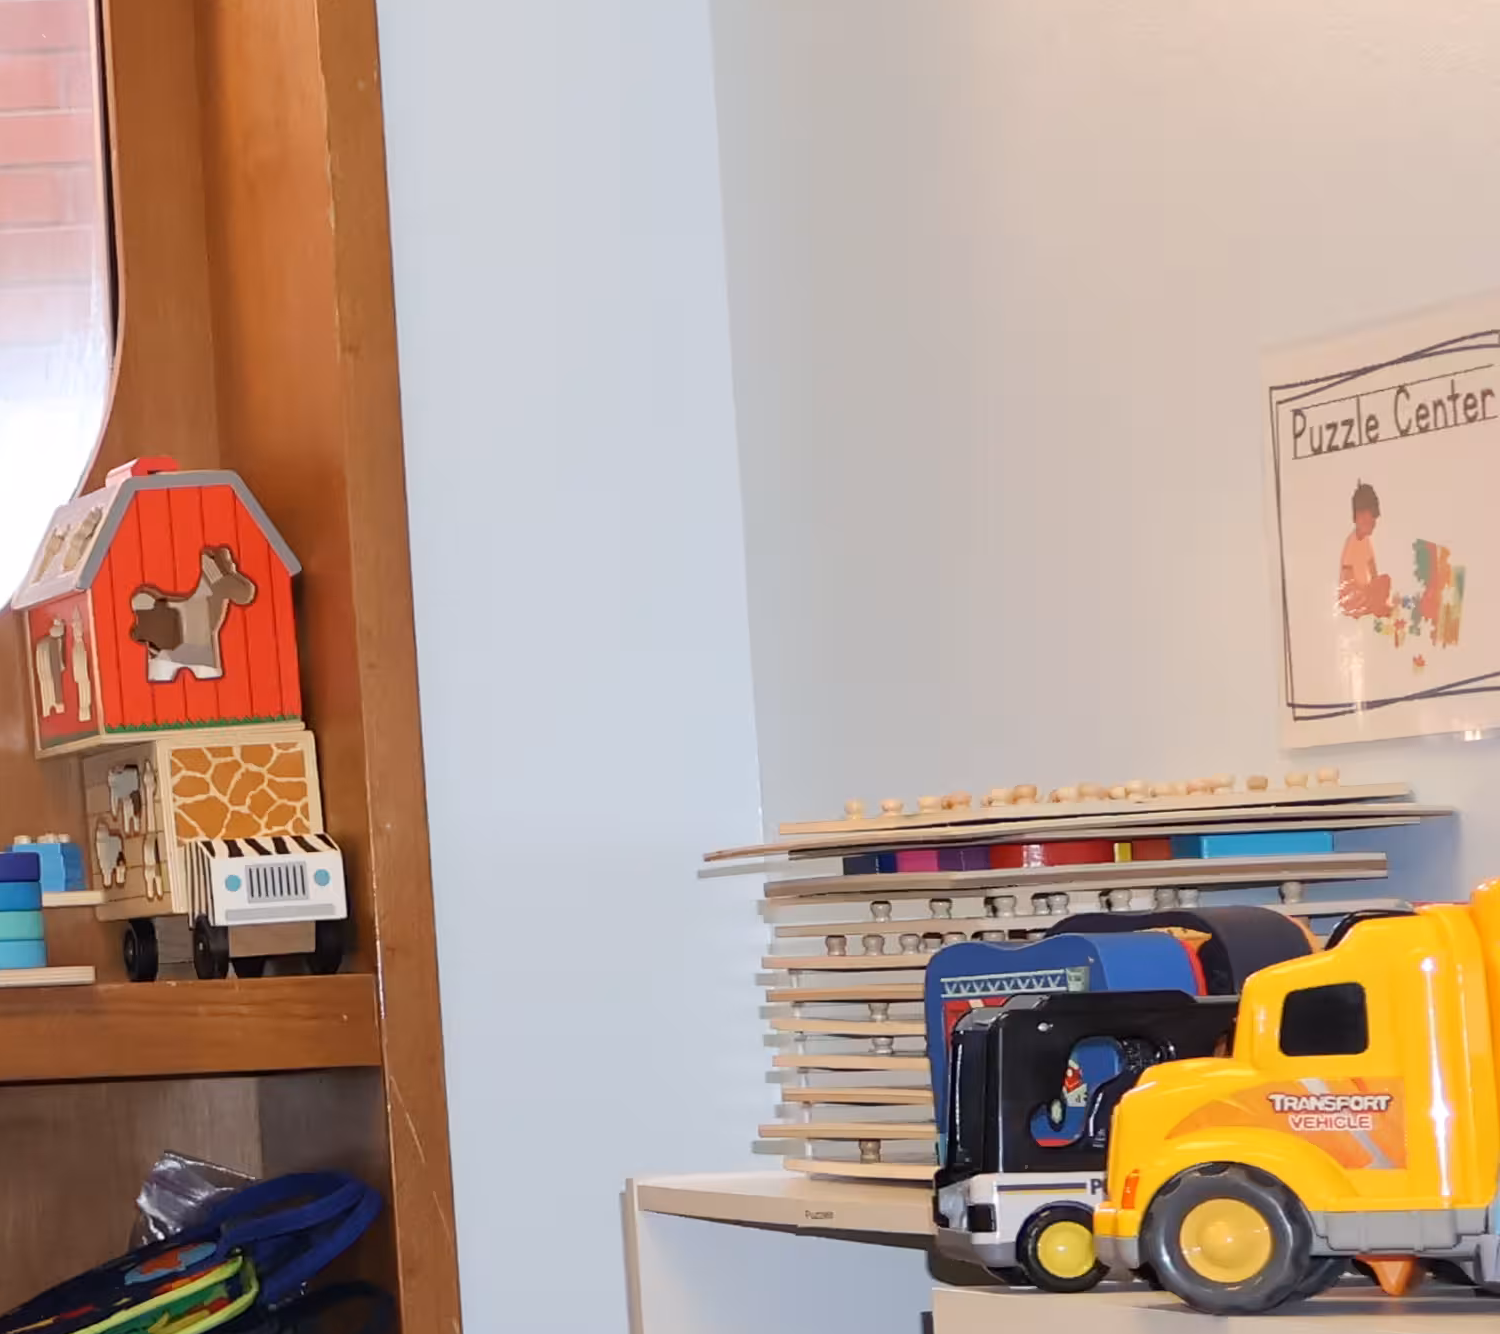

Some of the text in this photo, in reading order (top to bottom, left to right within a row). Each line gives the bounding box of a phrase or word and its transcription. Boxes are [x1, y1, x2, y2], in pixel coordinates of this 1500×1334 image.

[1291, 379, 1497, 459] Puzzle Center
[1267, 1093, 1393, 1113] TRANSPORT
[1289, 1114, 1372, 1131] VEHICLE
